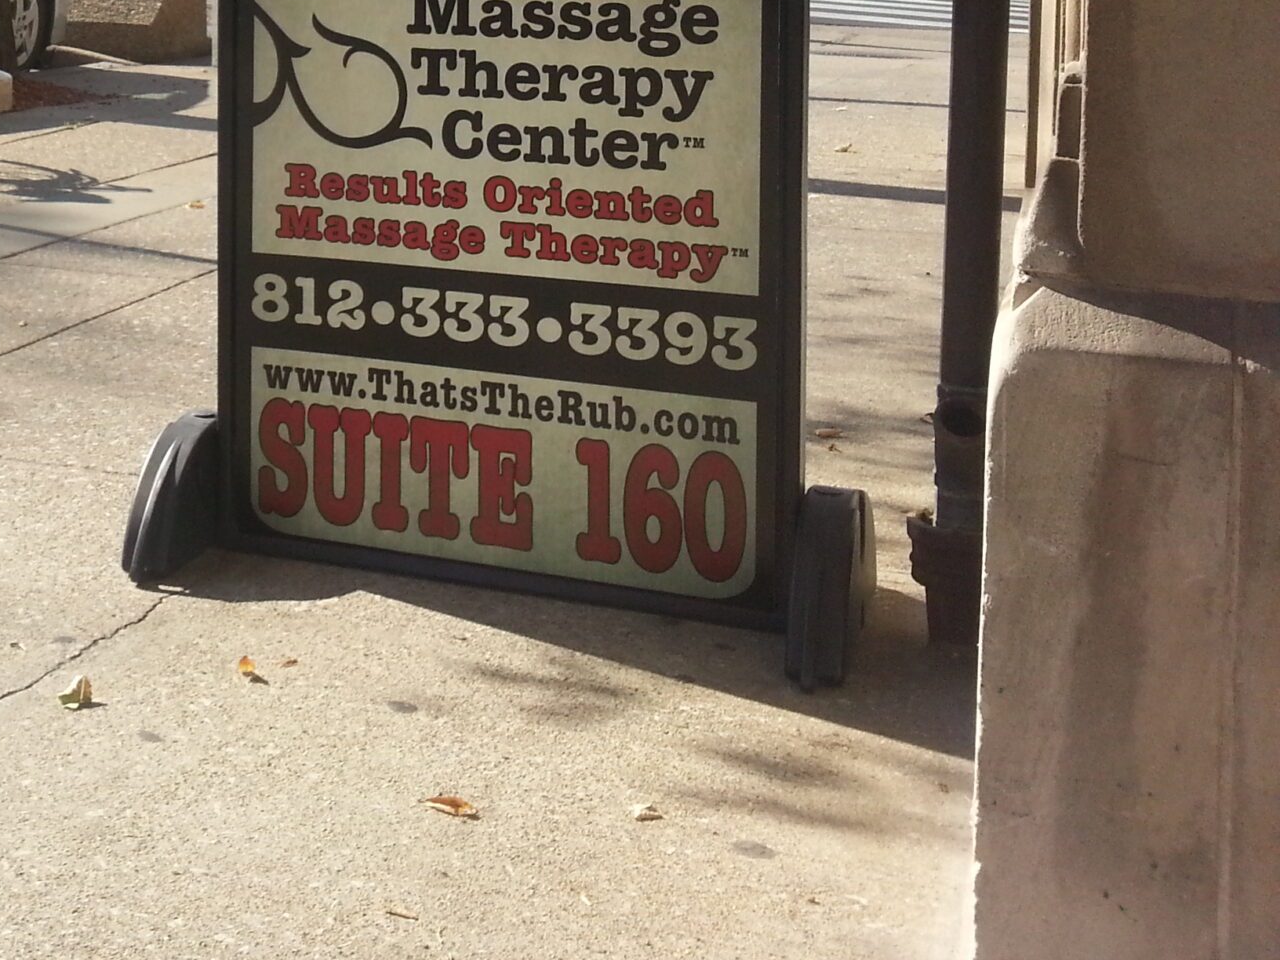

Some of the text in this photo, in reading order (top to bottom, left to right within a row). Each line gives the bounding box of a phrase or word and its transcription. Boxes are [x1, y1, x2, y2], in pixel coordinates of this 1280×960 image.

[411, 47, 715, 122] Therapy
[441, 110, 680, 170] Center
[284, 162, 719, 228] Results Oriented
[275, 204, 486, 261] Massage
[500, 221, 729, 283] Therapy
[263, 363, 741, 445] www.ThatsTheRub.com
[257, 397, 748, 583] SUITE 160
